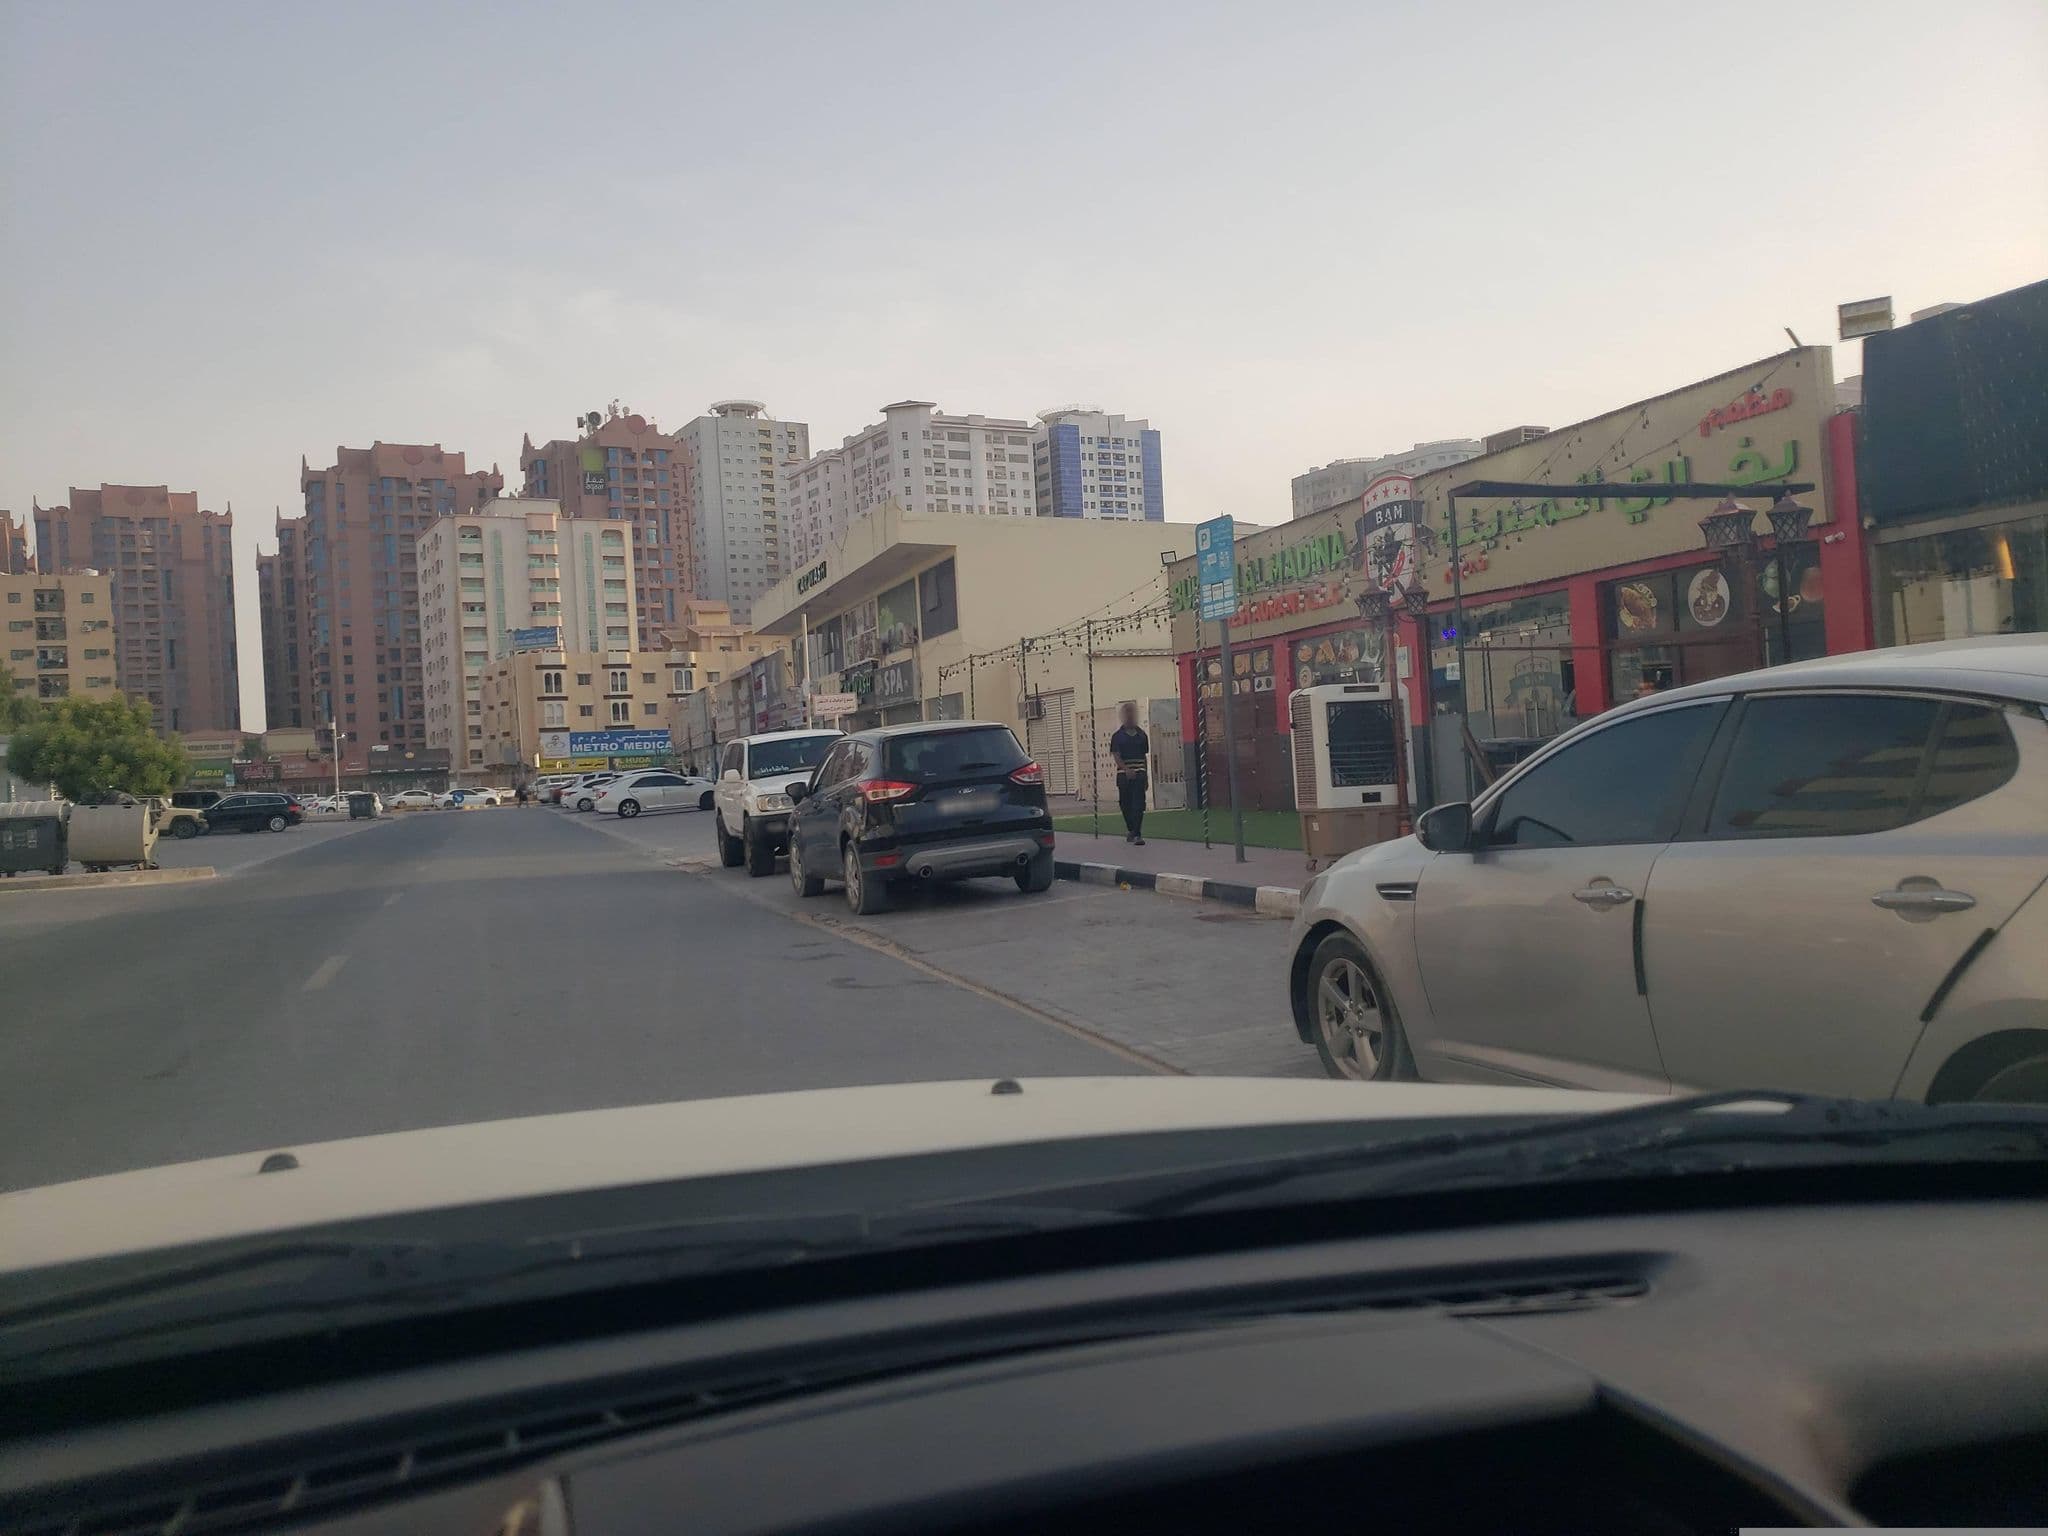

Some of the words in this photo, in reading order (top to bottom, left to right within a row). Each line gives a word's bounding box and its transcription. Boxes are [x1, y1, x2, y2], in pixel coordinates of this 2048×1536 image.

[1375, 503, 1404, 525] BAM
[1201, 532, 1208, 547] P
[1269, 530, 1345, 582] MADINA
[884, 667, 904, 697] SPA
[571, 742, 619, 753] METRO
